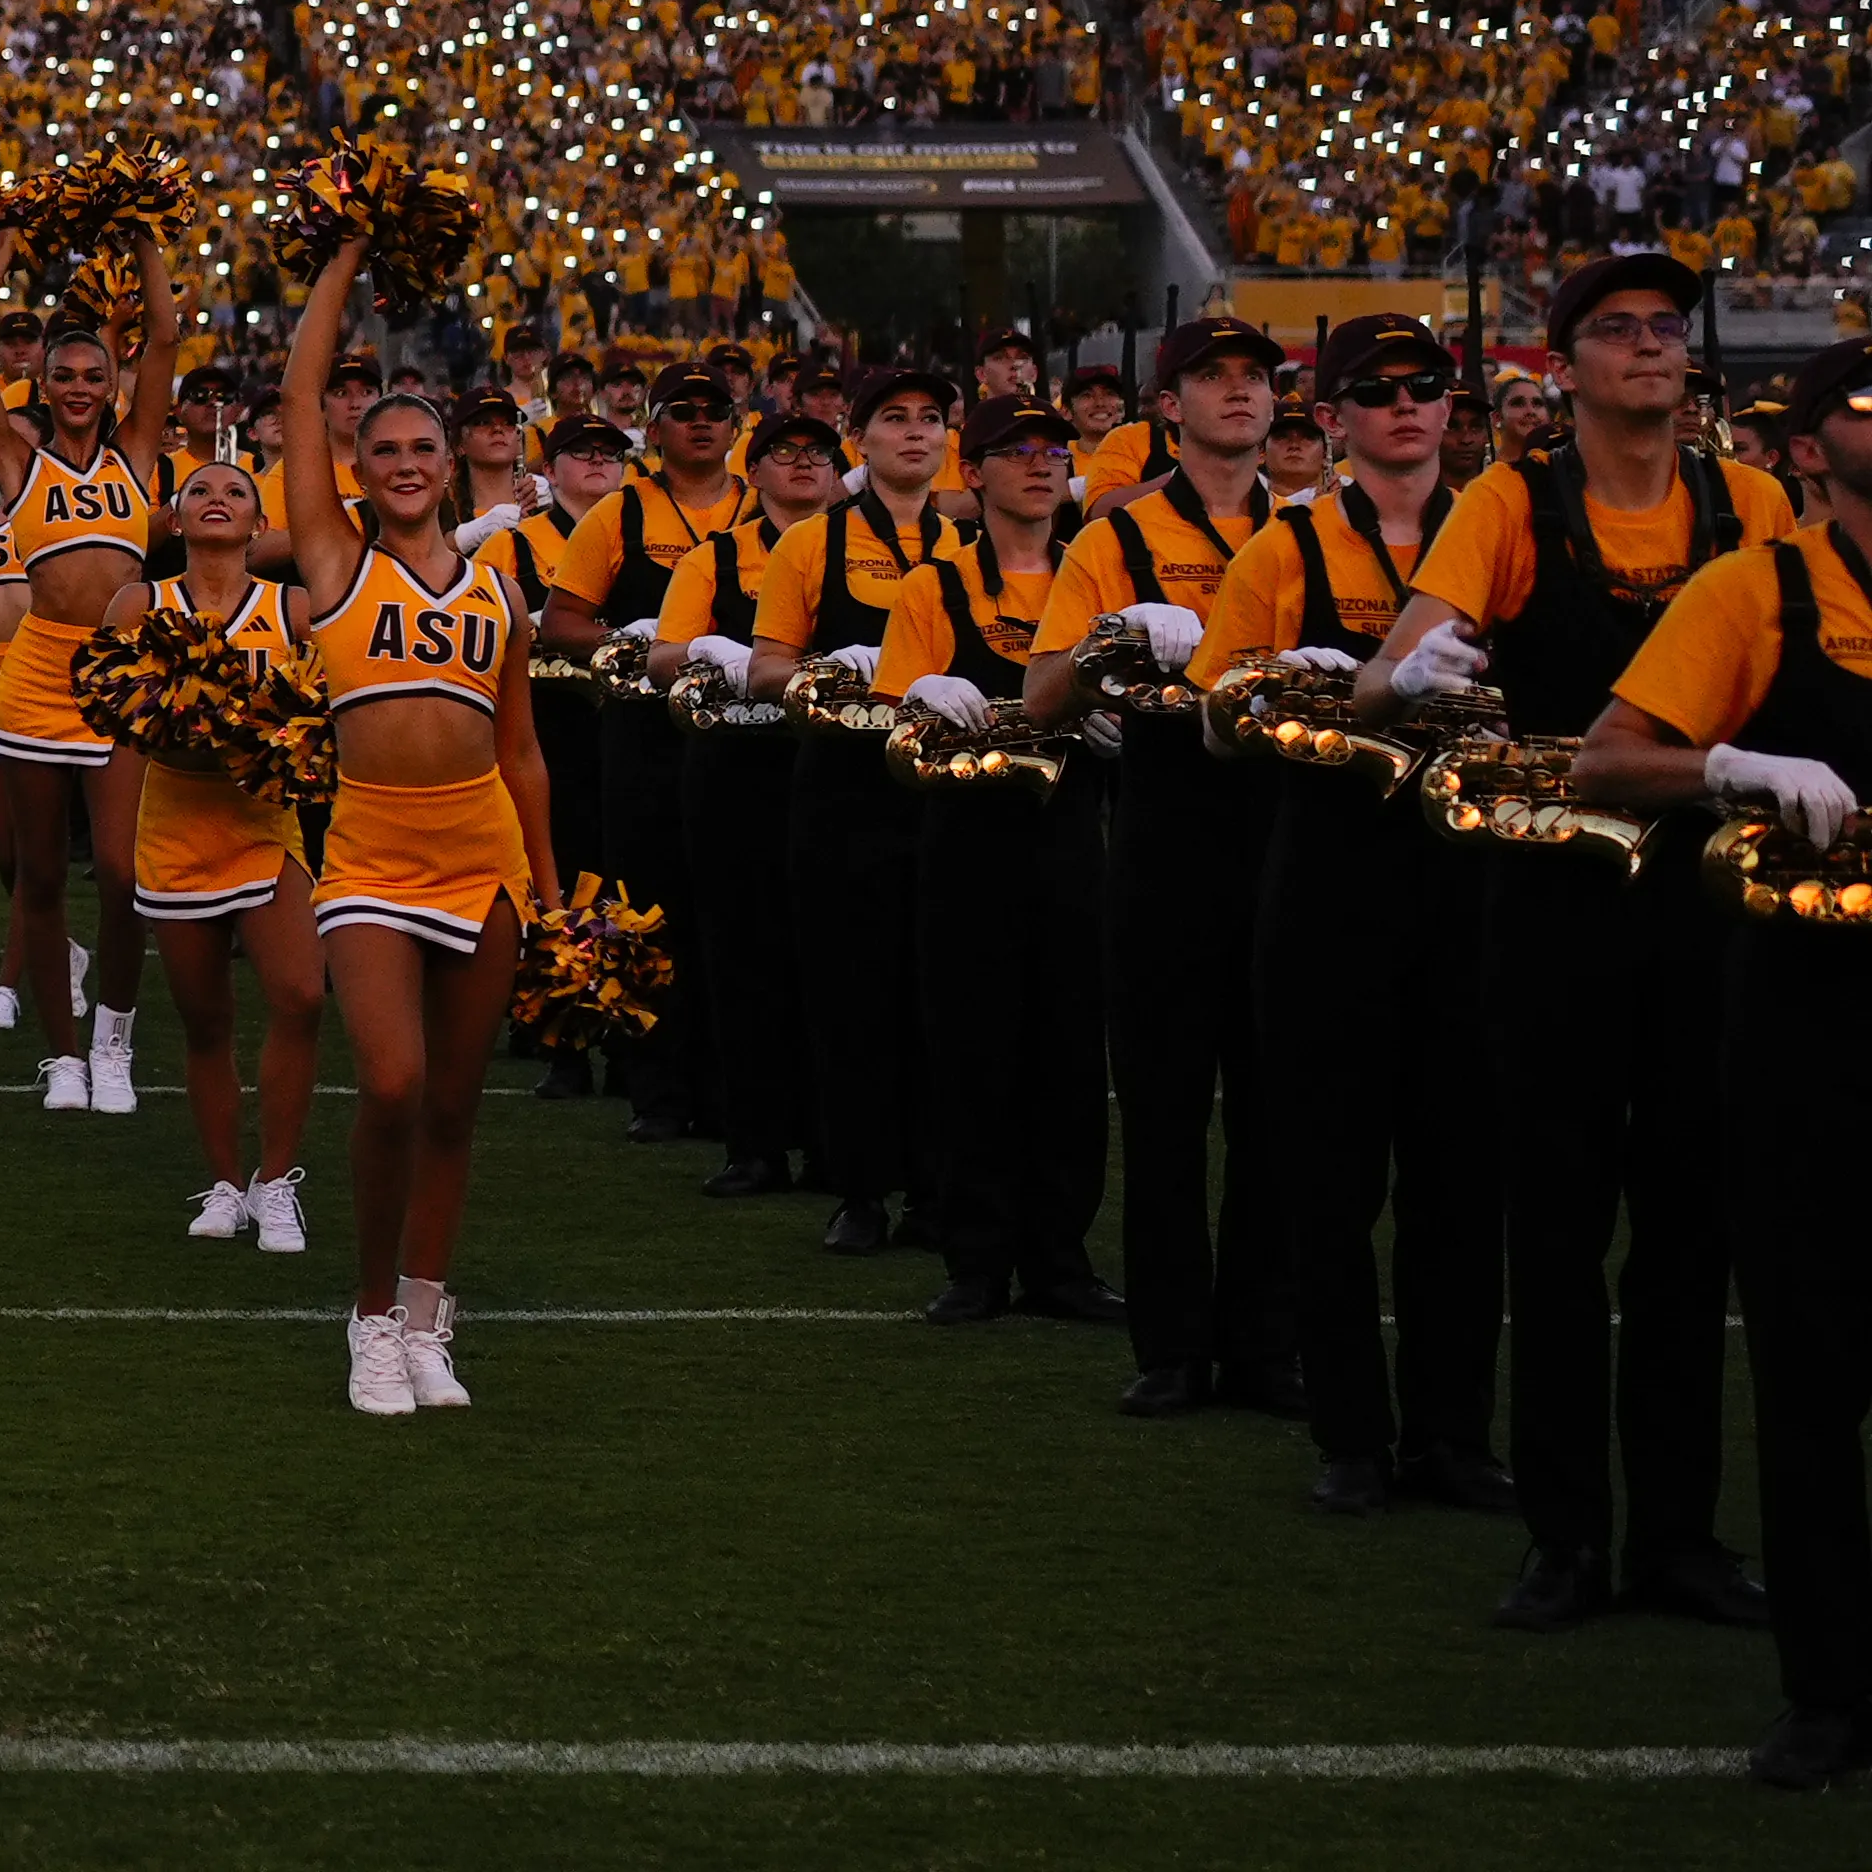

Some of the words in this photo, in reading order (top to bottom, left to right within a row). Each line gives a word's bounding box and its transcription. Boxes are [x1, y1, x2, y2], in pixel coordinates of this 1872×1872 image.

[42, 481, 132, 526] ASU
[1333, 598, 1390, 612] RIZONA
[365, 601, 499, 676] ASU
